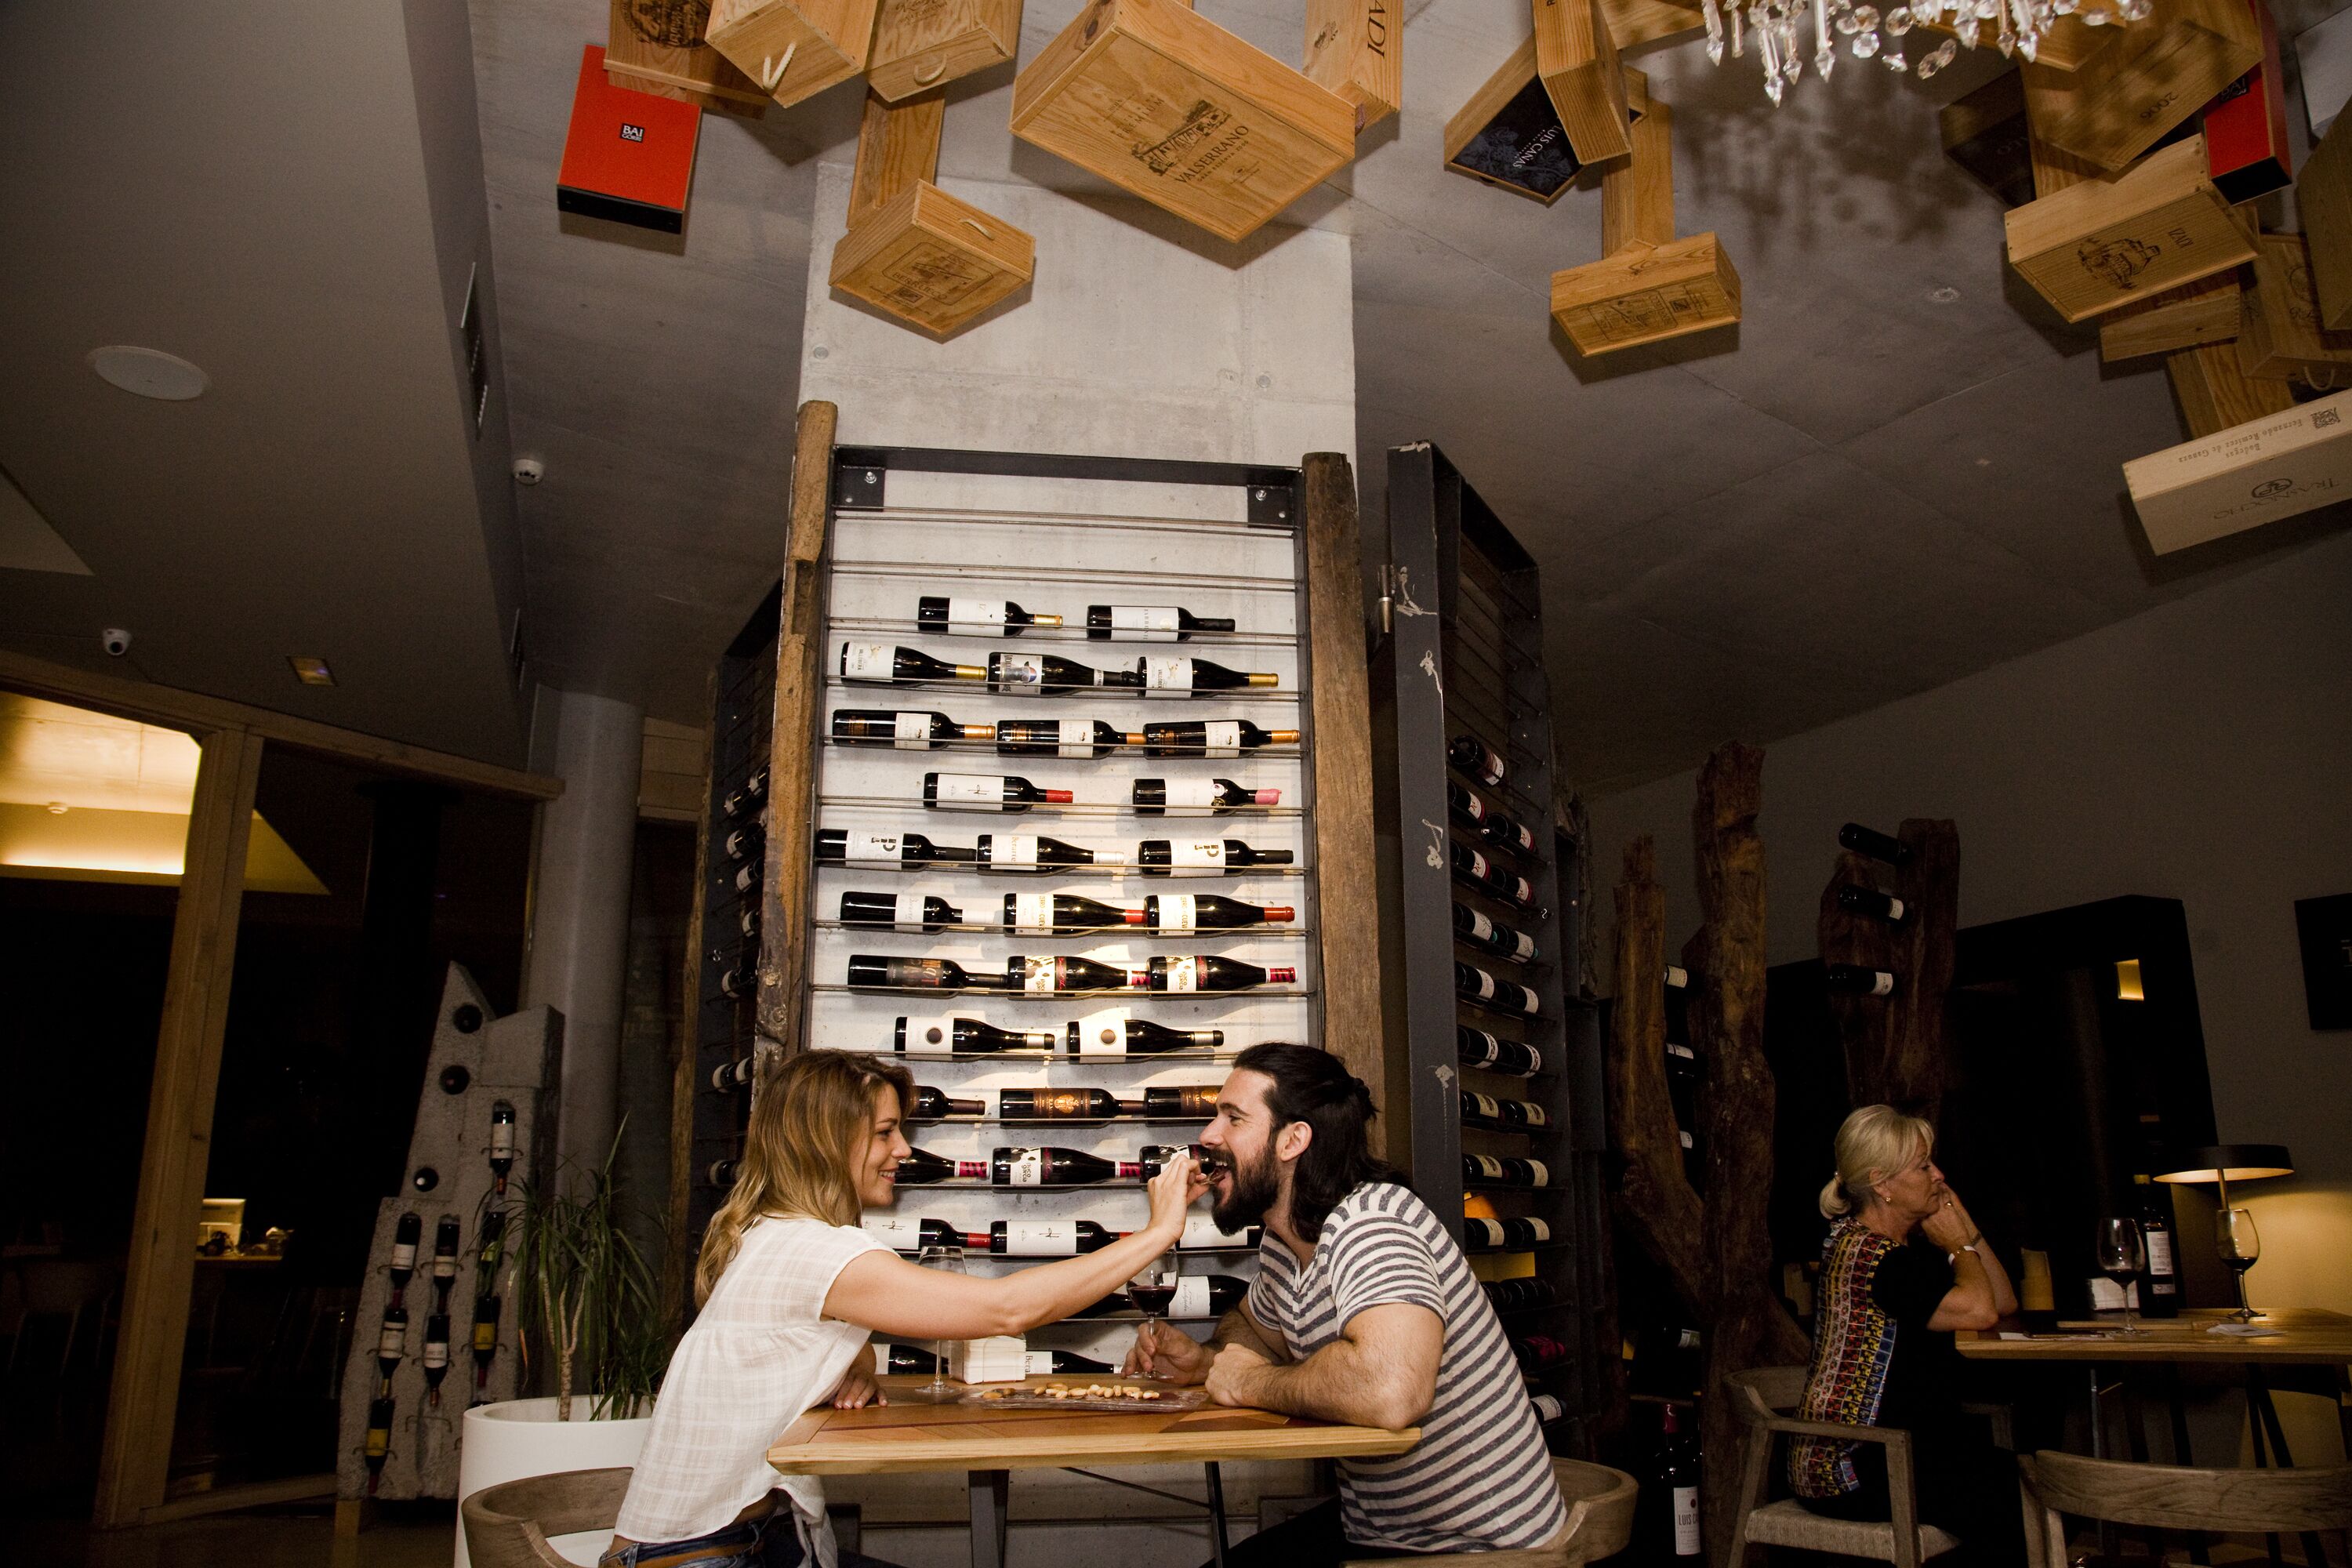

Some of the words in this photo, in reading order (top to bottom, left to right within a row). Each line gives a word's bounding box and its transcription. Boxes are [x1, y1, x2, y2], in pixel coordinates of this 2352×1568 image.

[2138, 91, 2180, 121] 2006
[622, 125, 644, 136] BAI
[1540, 124, 1563, 145] LUIS
[1174, 124, 1250, 184] VALSERRANO
[1678, 1514, 1692, 1526] LUIS
